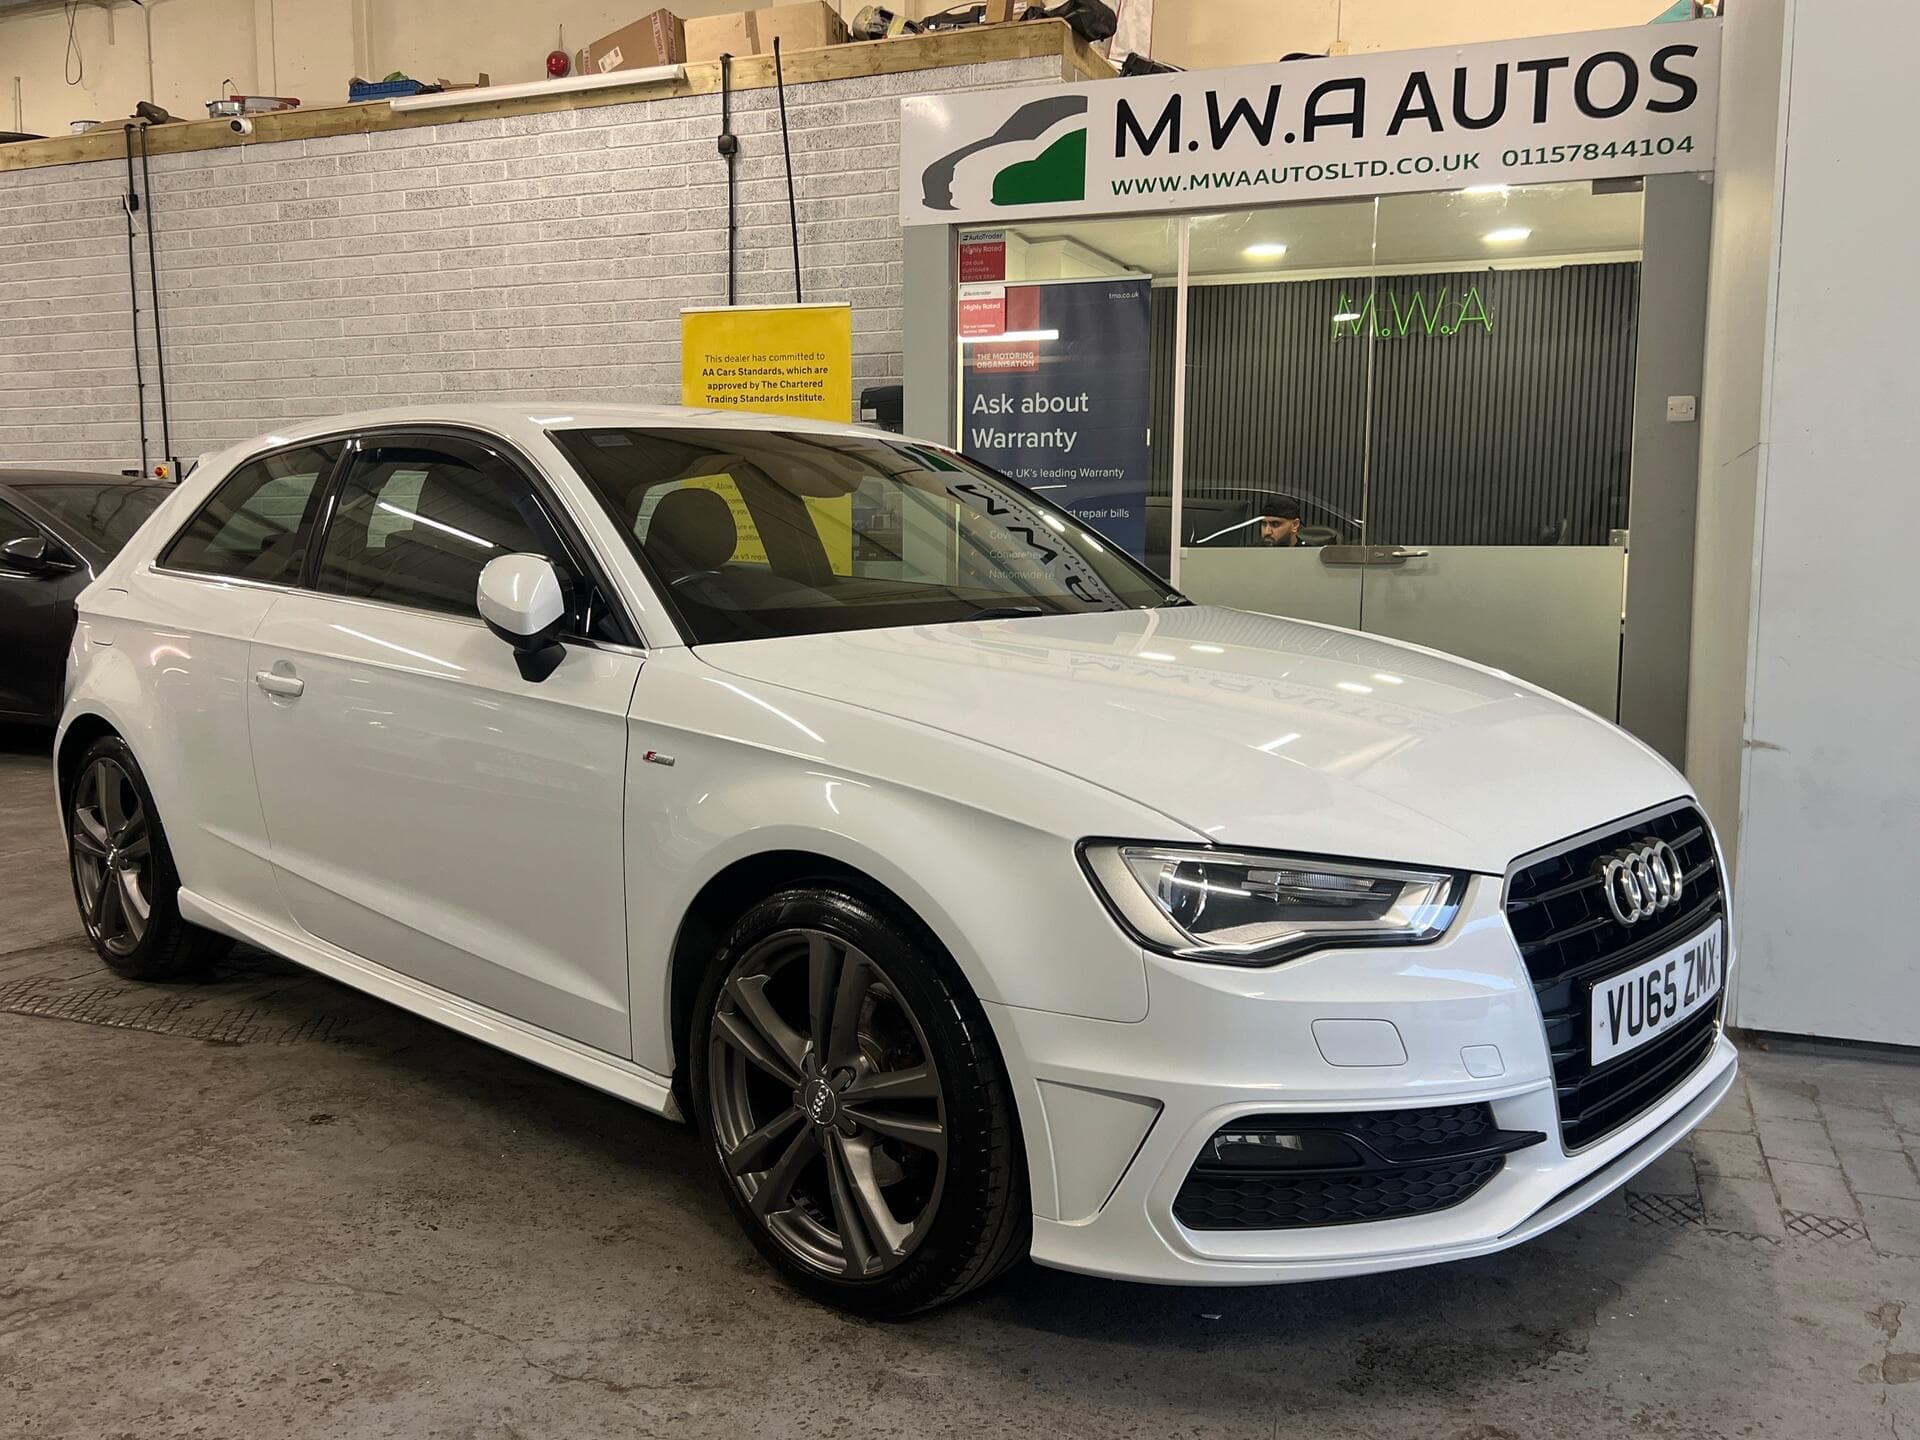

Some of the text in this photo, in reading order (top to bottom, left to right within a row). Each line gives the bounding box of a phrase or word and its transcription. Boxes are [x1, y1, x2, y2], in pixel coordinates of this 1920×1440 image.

[1114, 43, 1699, 159] M.W.A AUTOS
[1111, 134, 1695, 197] WWW.MWAAUTOSLTD.CO.UK 01157844104
[963, 302, 1001, 313] Highly Rated
[1333, 286, 1492, 339] M.W.A
[704, 352, 826, 363] This dealer has committed to
[976, 351, 1034, 361] THE MOTORING
[976, 359, 1035, 369] ORGANISATION
[702, 366, 828, 377] AA Cars Standards, which are
[707, 379, 823, 391] approved by The Chartered
[706, 393, 826, 405] Trading Standards Institute.
[971, 392, 1089, 415] Ask about
[971, 427, 1078, 453] Warranty
[1015, 468, 1038, 479] UK's
[1040, 467, 1077, 480] leading
[1079, 467, 1125, 480] Warranty
[1078, 508, 1108, 521] repair
[1110, 508, 1130, 519] bills
[1607, 933, 1717, 1046] VU65 ZMX
